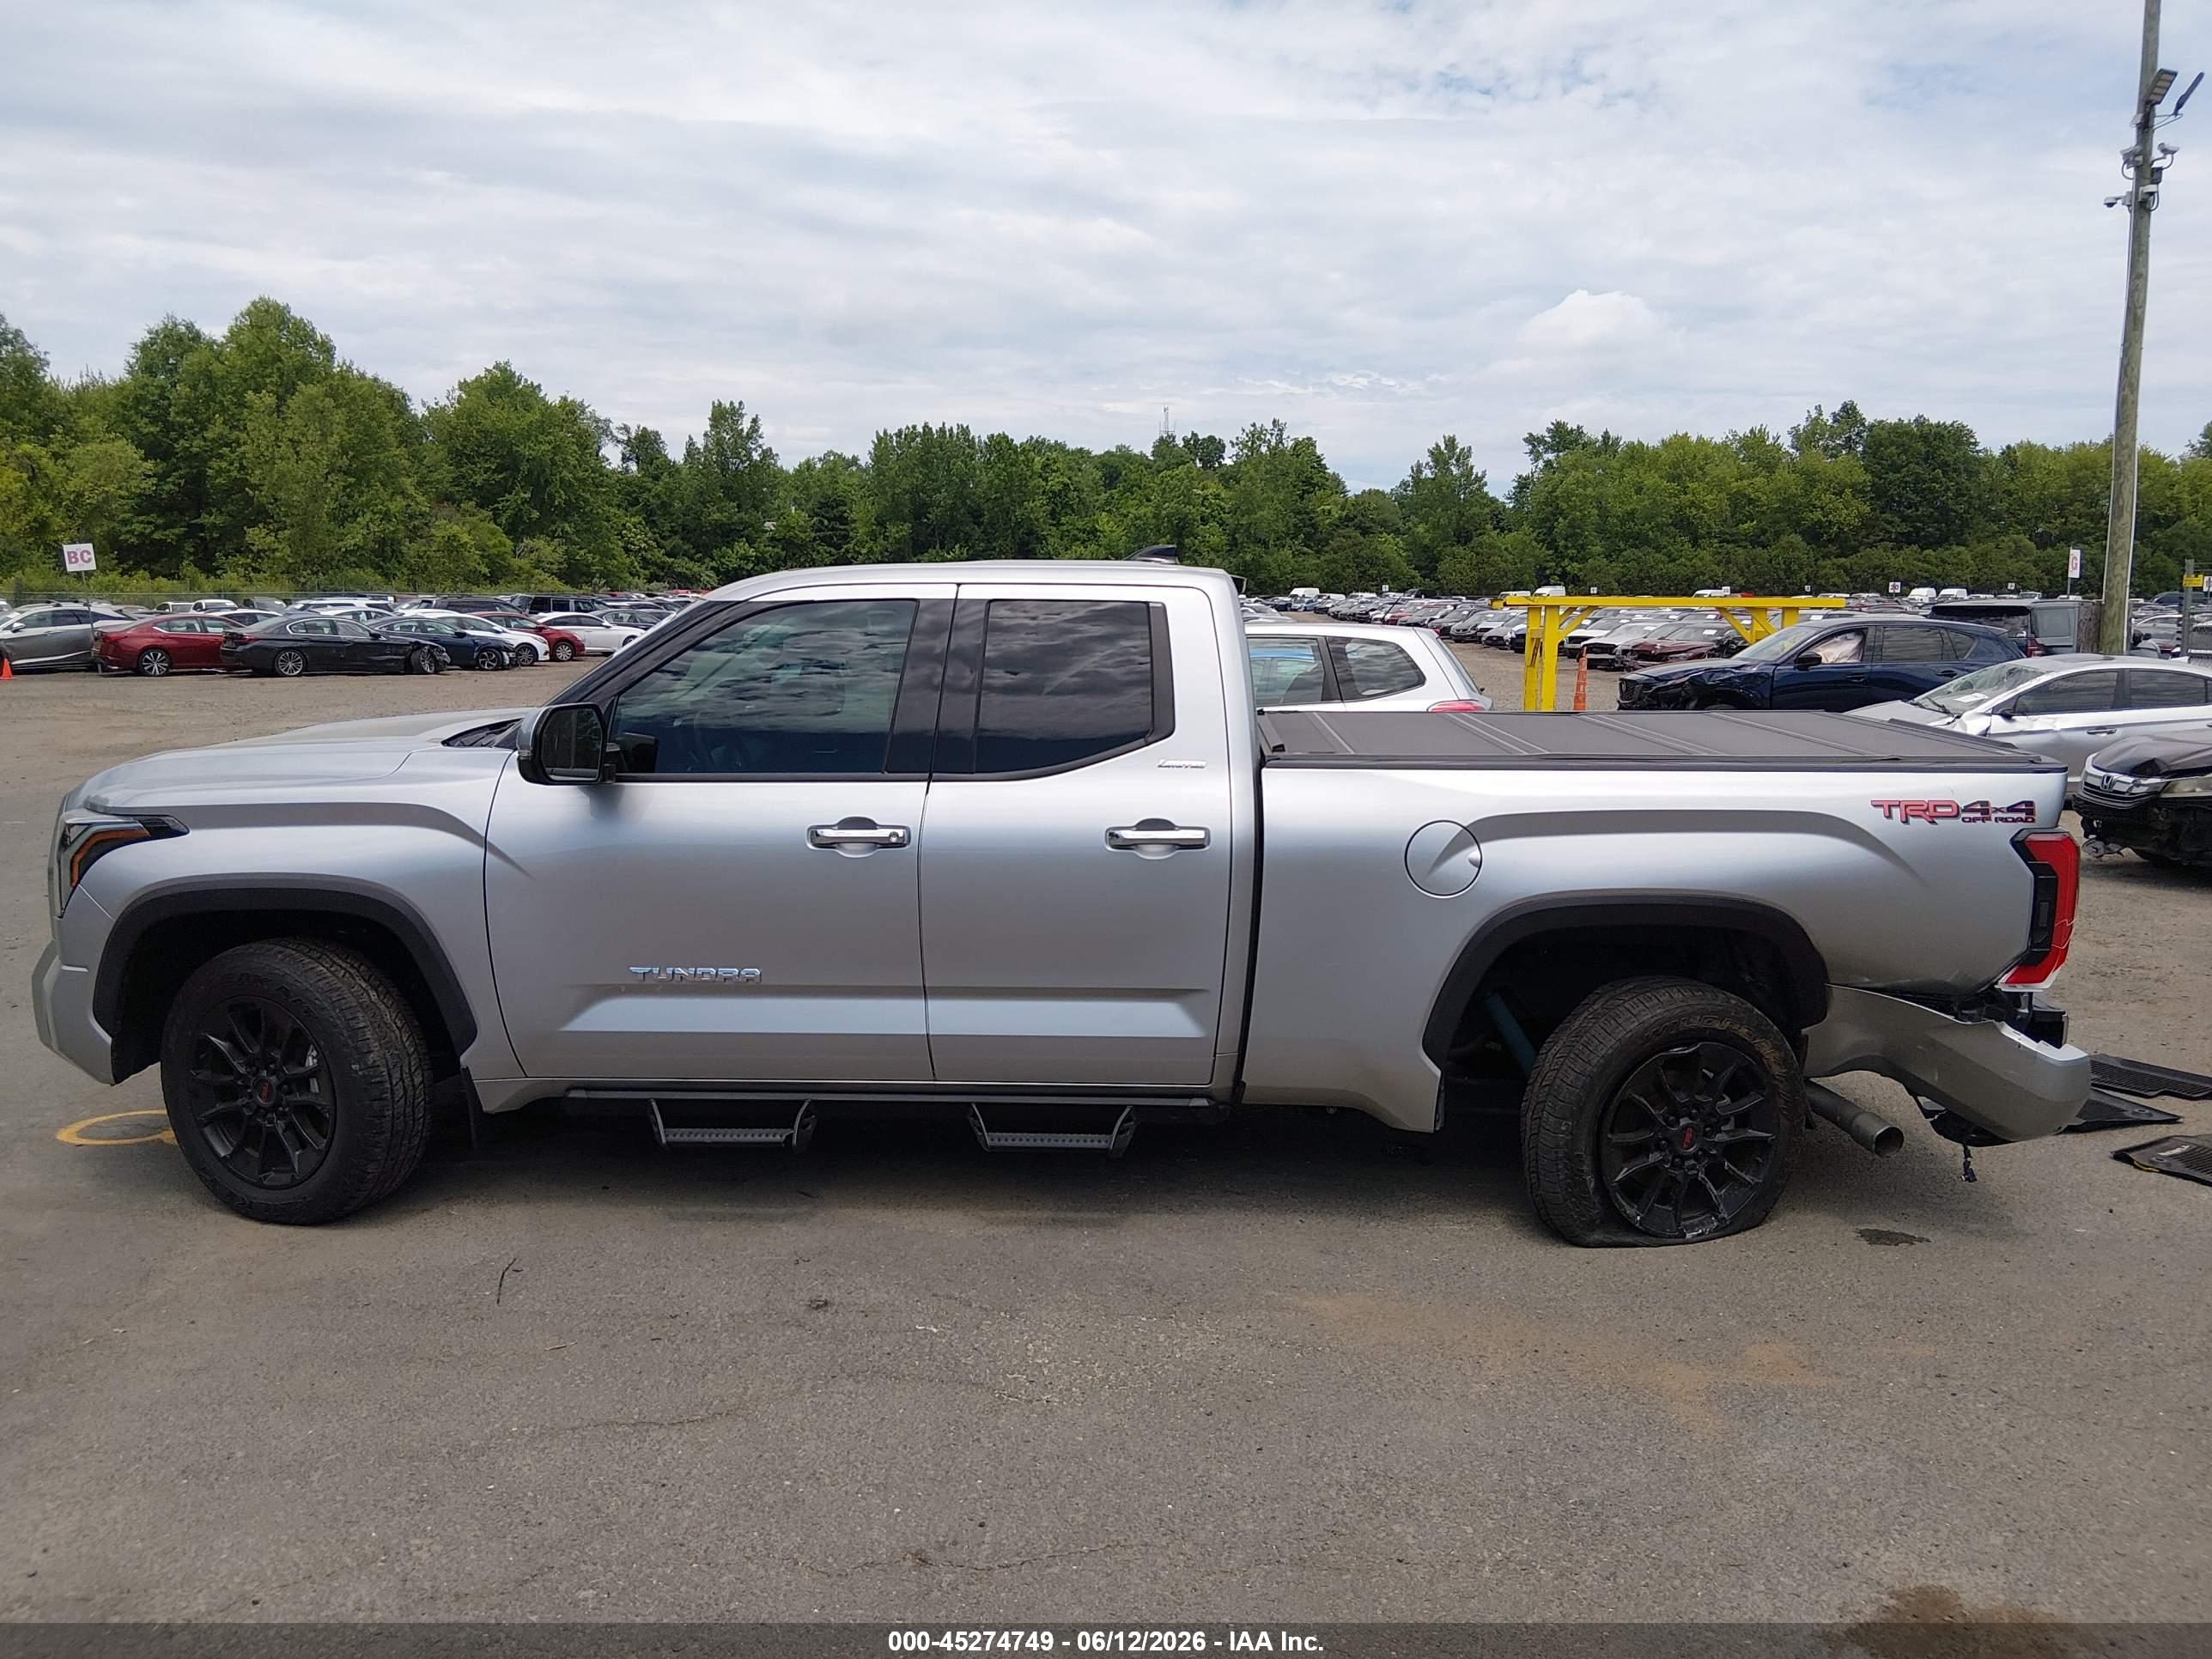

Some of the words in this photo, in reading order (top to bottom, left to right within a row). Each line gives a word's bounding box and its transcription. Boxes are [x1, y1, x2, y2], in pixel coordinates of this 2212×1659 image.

[67, 550, 92, 564] BC
[1871, 800, 1960, 825] TRD
[1961, 800, 2036, 817] 4x4
[629, 967, 763, 983] TUNDRA
